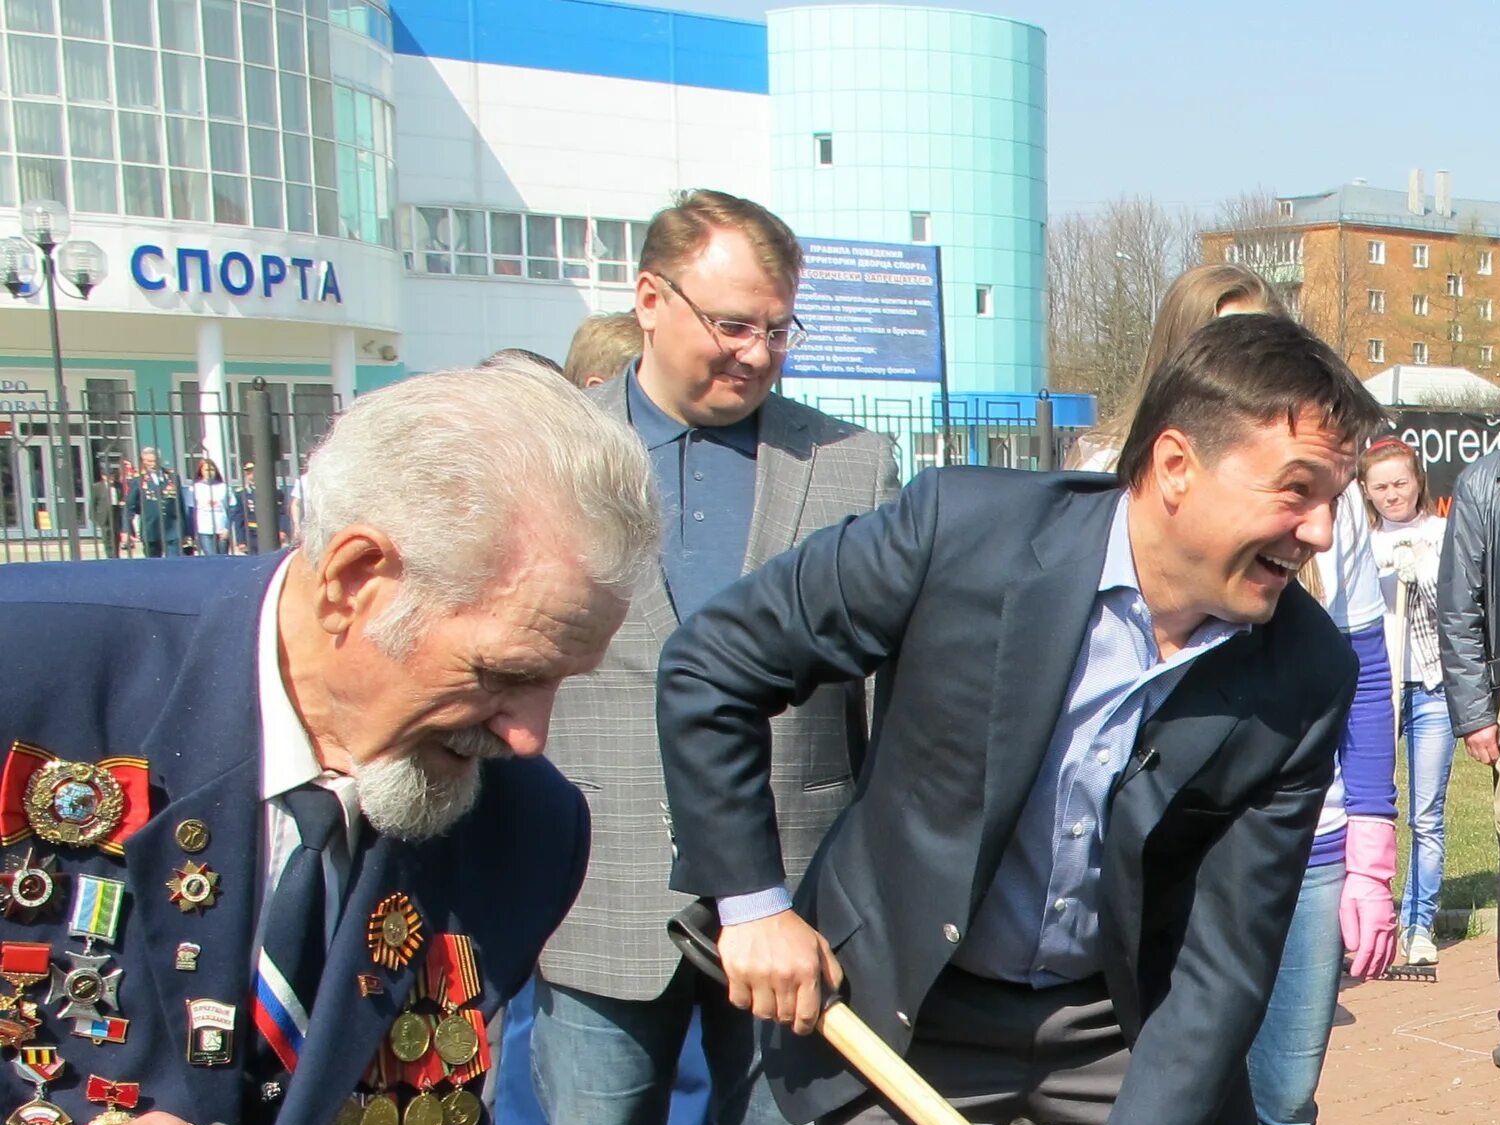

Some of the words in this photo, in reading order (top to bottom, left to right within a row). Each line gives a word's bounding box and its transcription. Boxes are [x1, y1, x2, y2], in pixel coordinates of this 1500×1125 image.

[810, 244, 850, 255] ПРАВИЛА
[852, 247, 903, 258] ПОВЕДЕНИЯ
[857, 258, 893, 269] ДВОРЦА
[893, 261, 927, 271] СПОРТА
[130, 244, 342, 303] СПОРТА
[800, 269, 862, 281] ЕГОРИЧЕСКИ
